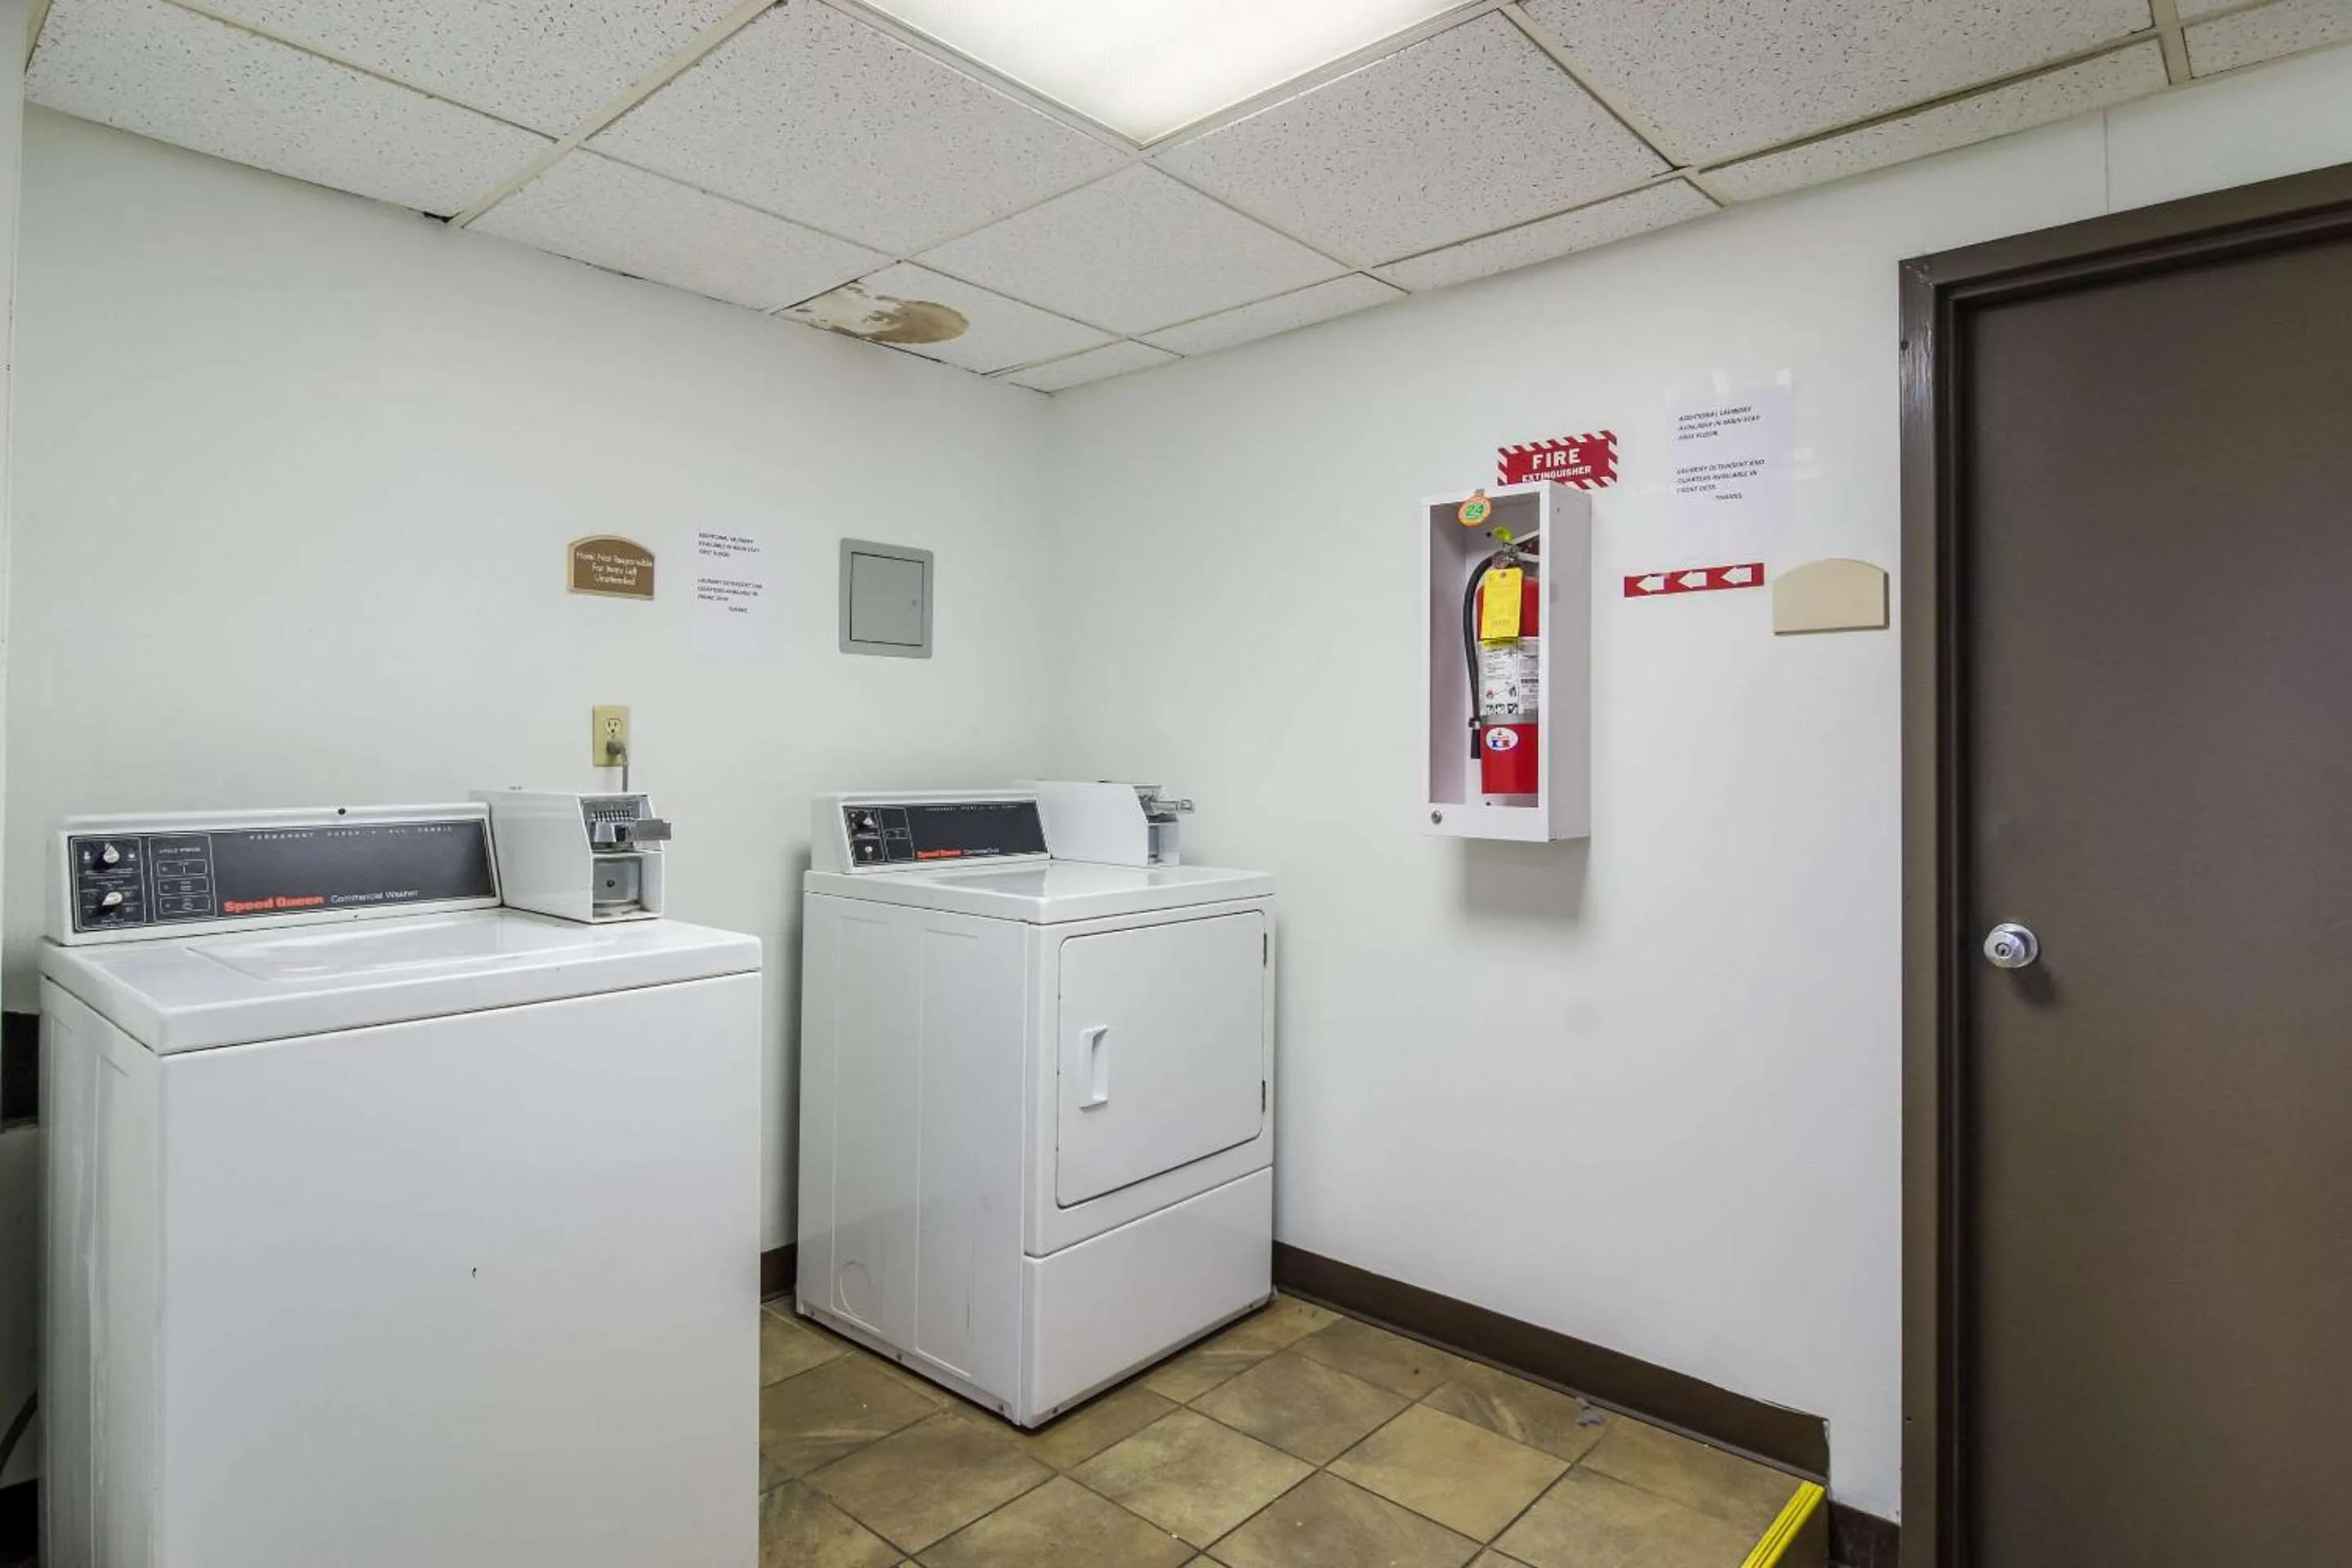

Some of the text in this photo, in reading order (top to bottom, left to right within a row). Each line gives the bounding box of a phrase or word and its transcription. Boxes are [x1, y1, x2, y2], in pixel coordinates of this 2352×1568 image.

[1719, 407, 1753, 416] LAUNDRY
[1532, 448, 1581, 470] FIRE
[1521, 465, 1592, 483] EXTINGUISHER
[224, 889, 419, 913] Speed Queen Commercial Washer
